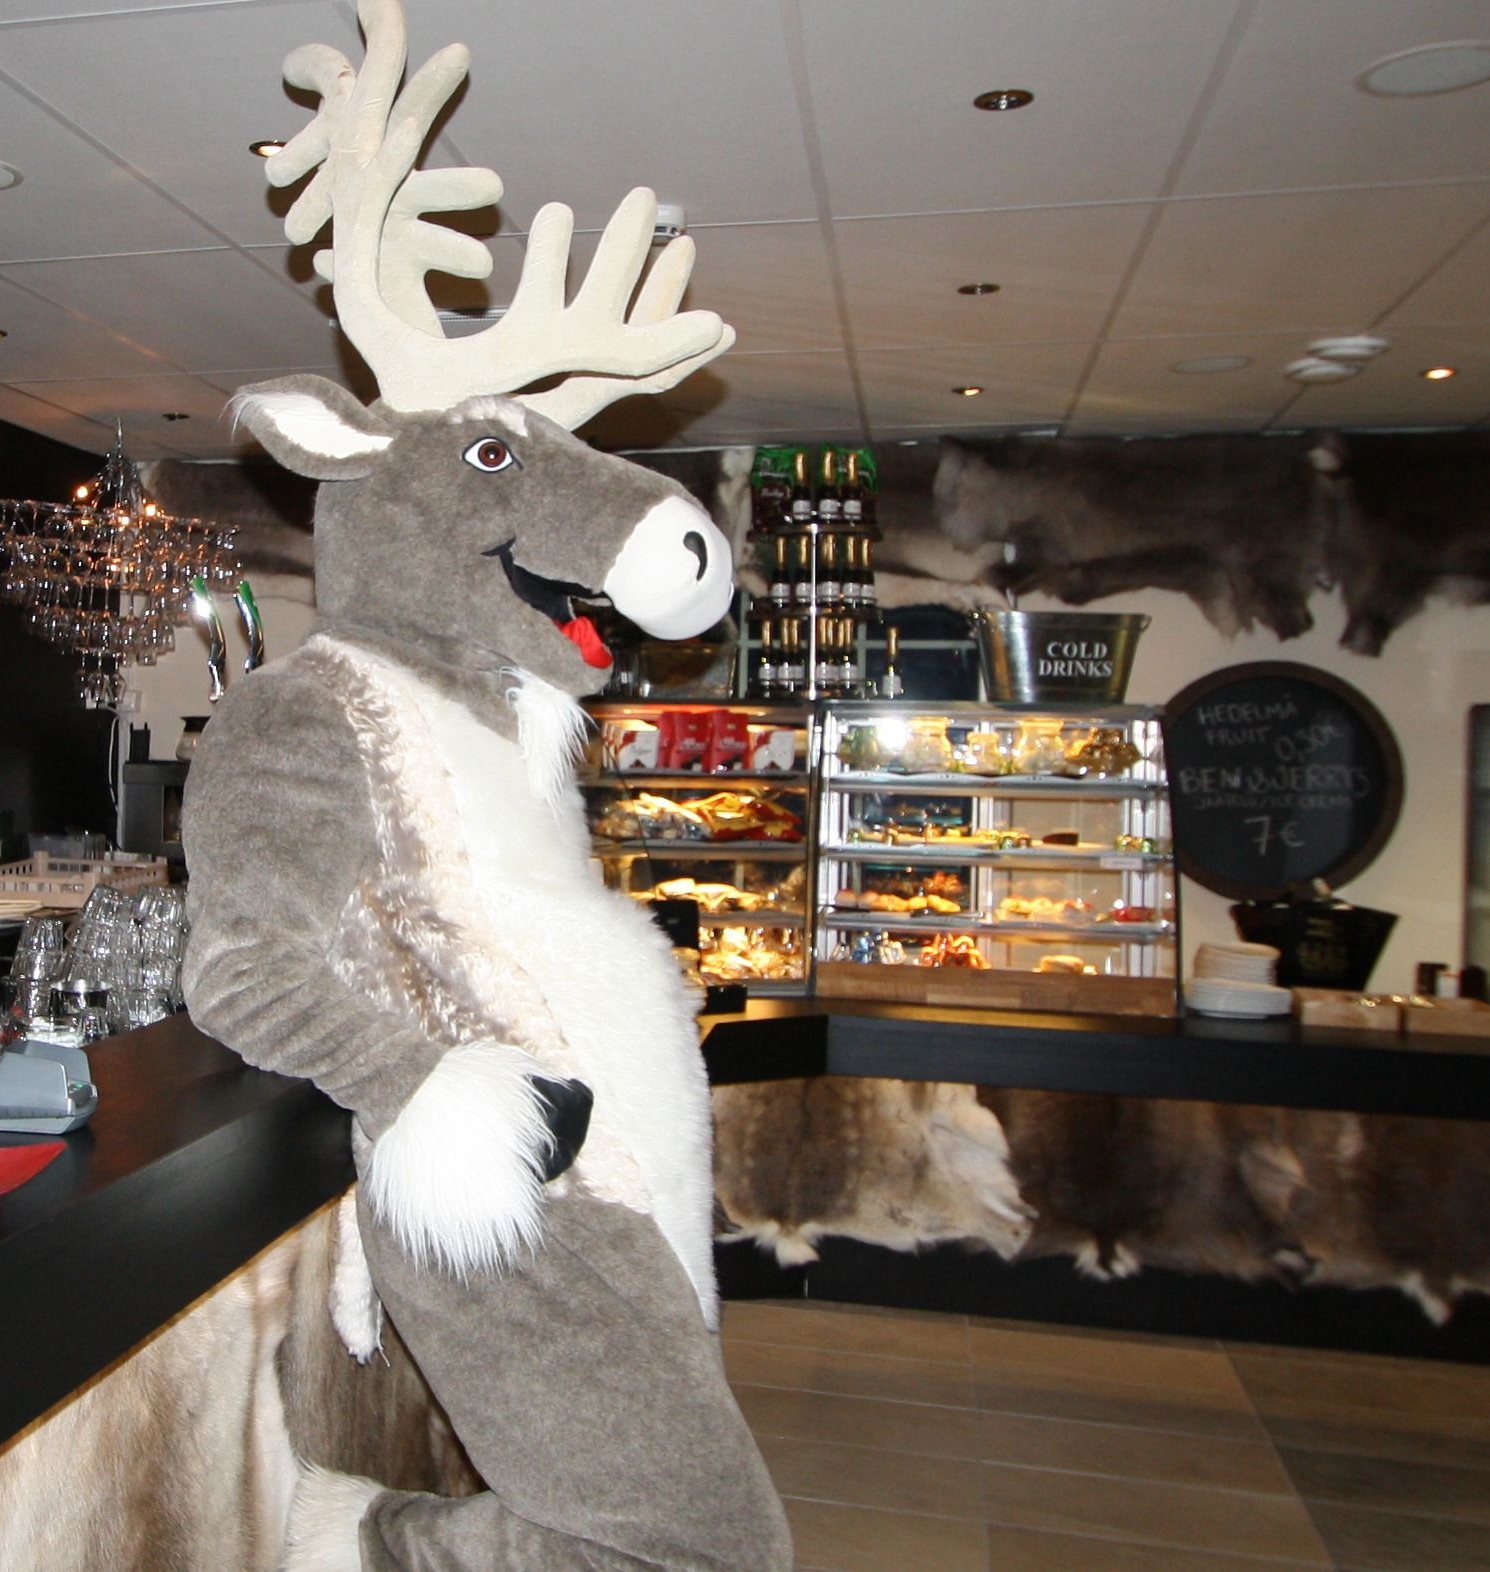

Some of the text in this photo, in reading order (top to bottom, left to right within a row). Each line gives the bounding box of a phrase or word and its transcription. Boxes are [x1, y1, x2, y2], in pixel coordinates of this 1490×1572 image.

[1046, 640, 1109, 660] COLD
[1038, 658, 1114, 677] DRINKS
[1206, 726, 1271, 746] FRUIT
[1244, 815, 1307, 857] 7 €
